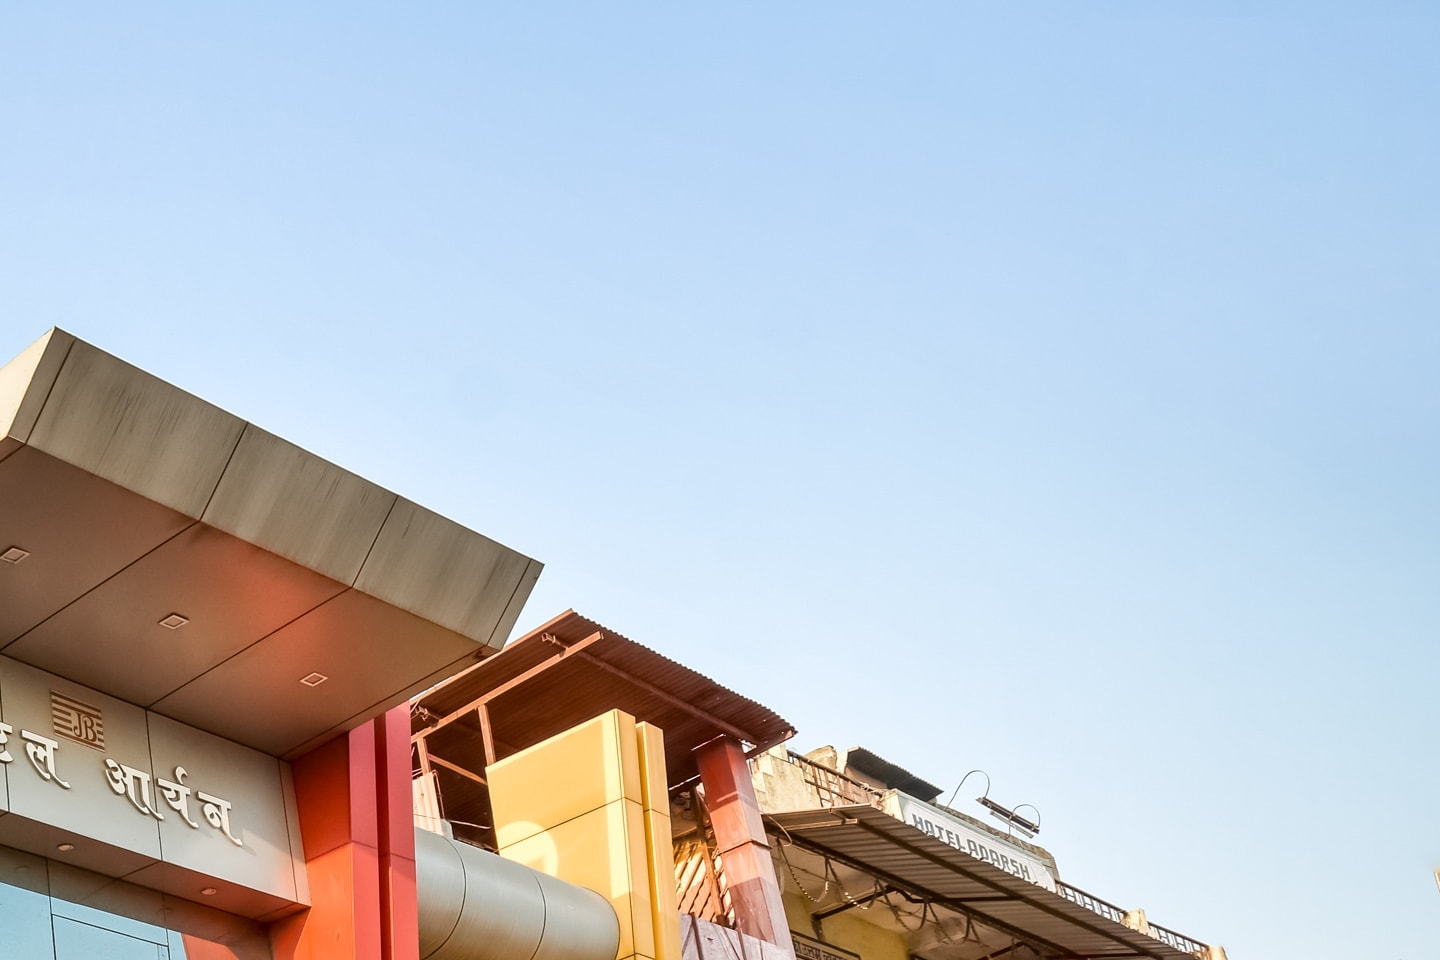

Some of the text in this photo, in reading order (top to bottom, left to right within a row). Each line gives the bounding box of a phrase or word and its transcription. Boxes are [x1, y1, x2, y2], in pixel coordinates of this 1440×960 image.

[105, 758, 243, 847] आर्यन
[912, 813, 1032, 881] HOTEL ADARSH
